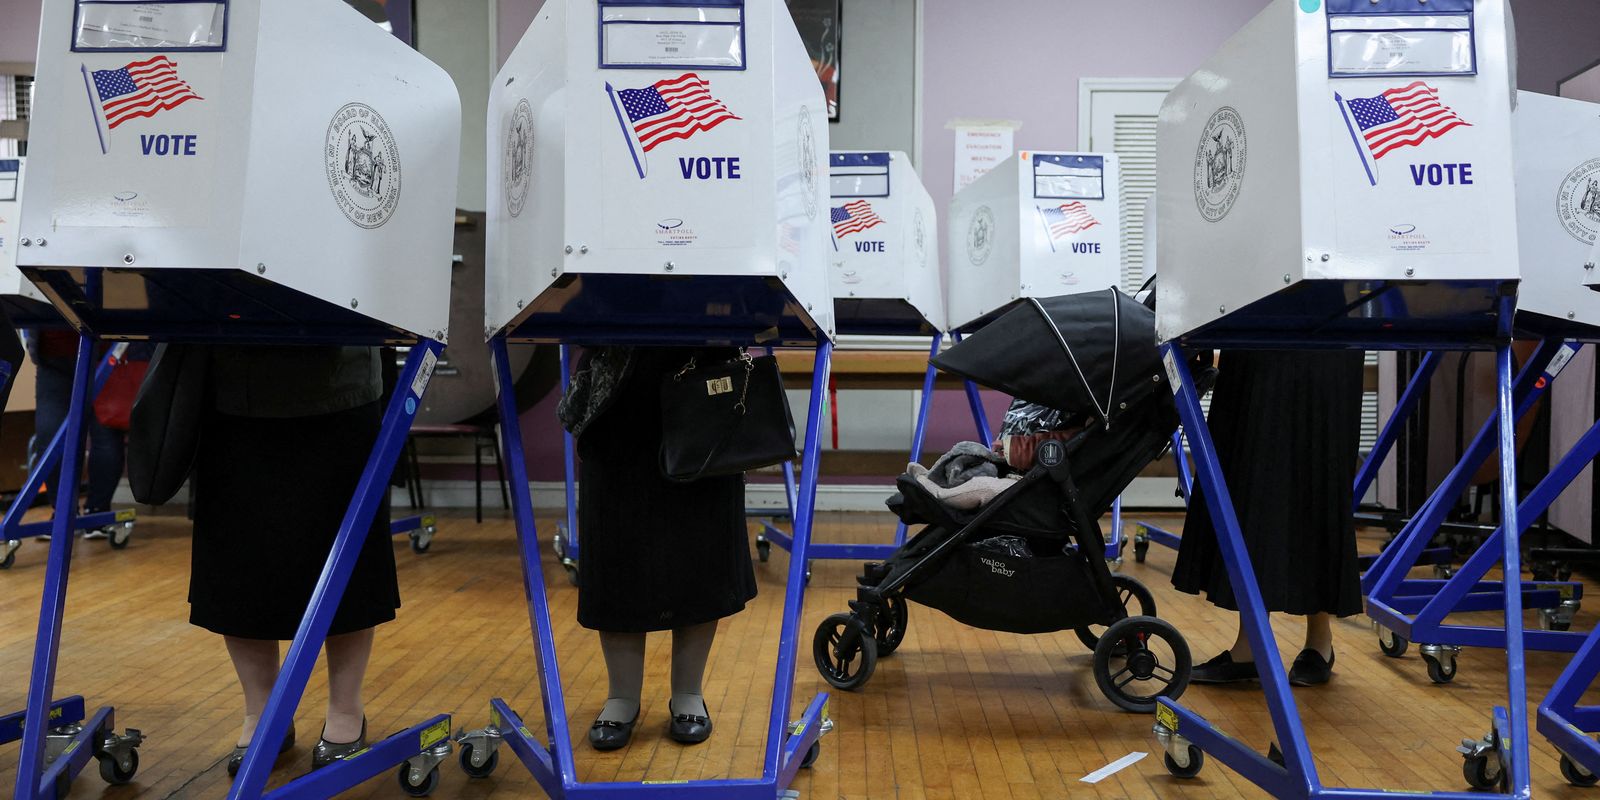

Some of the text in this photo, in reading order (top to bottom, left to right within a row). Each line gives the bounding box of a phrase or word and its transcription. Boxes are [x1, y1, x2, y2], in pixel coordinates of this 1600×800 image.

[334, 108, 357, 133] BOARD
[358, 108, 369, 118] OF
[140, 134, 198, 156] VOTE
[678, 156, 741, 180] VOTE
[1409, 163, 1474, 186] VOTE
[336, 189, 355, 213] CITY
[354, 209, 366, 221] OF
[366, 210, 383, 223] NEW
[854, 240, 885, 253] VOTE
[1071, 242, 1101, 254] VOTE
[981, 557, 1006, 568] valco
[991, 566, 1015, 577] baby
